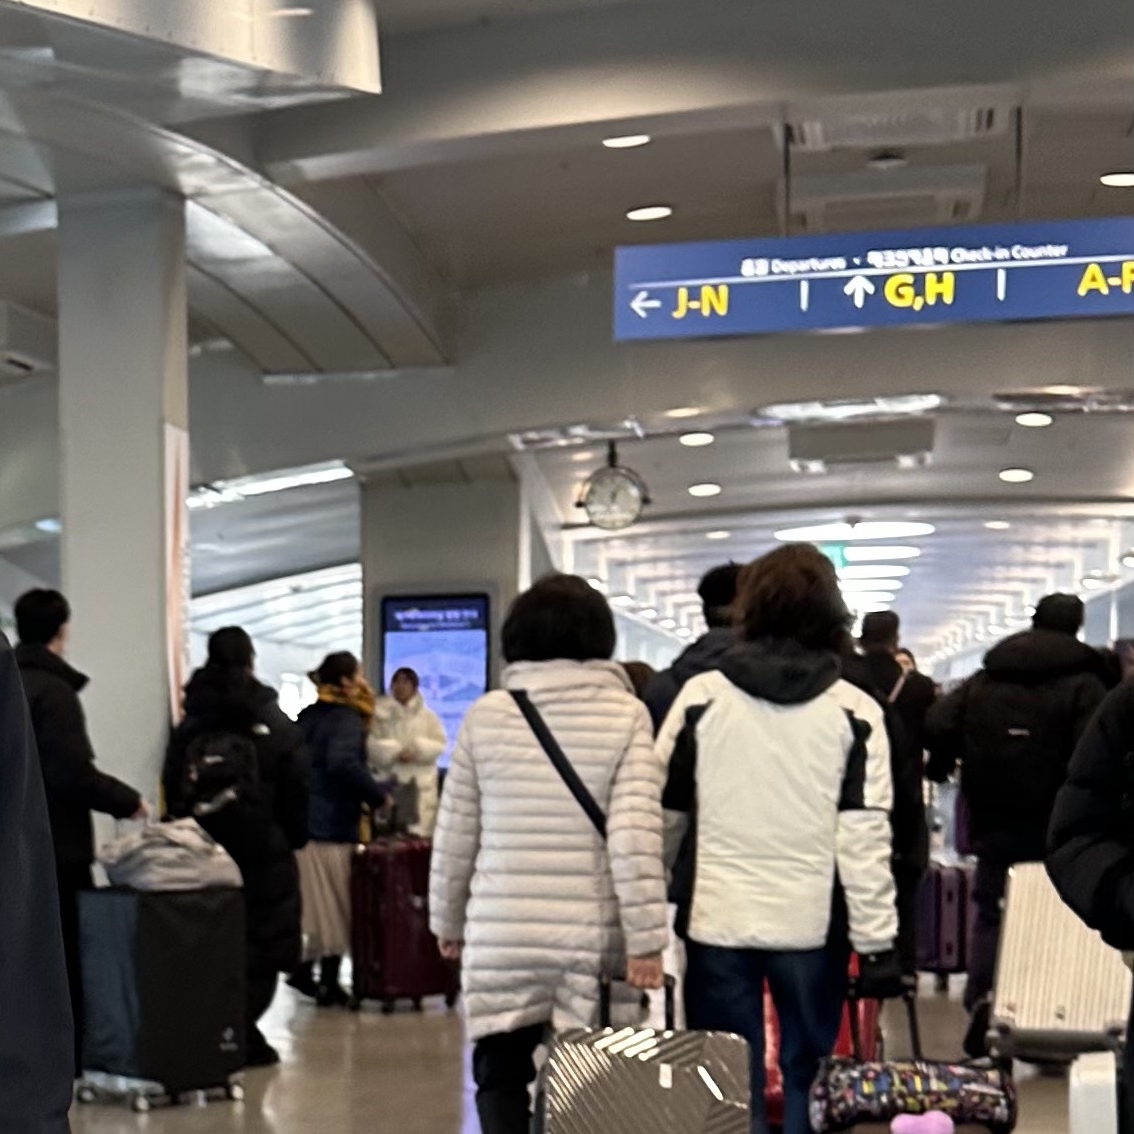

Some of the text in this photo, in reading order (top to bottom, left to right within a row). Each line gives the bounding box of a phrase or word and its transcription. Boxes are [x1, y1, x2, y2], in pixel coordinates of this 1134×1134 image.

[1012, 244, 1068, 260] Counter
[672, 284, 729, 319] J-N
[883, 271, 955, 312] G,H
